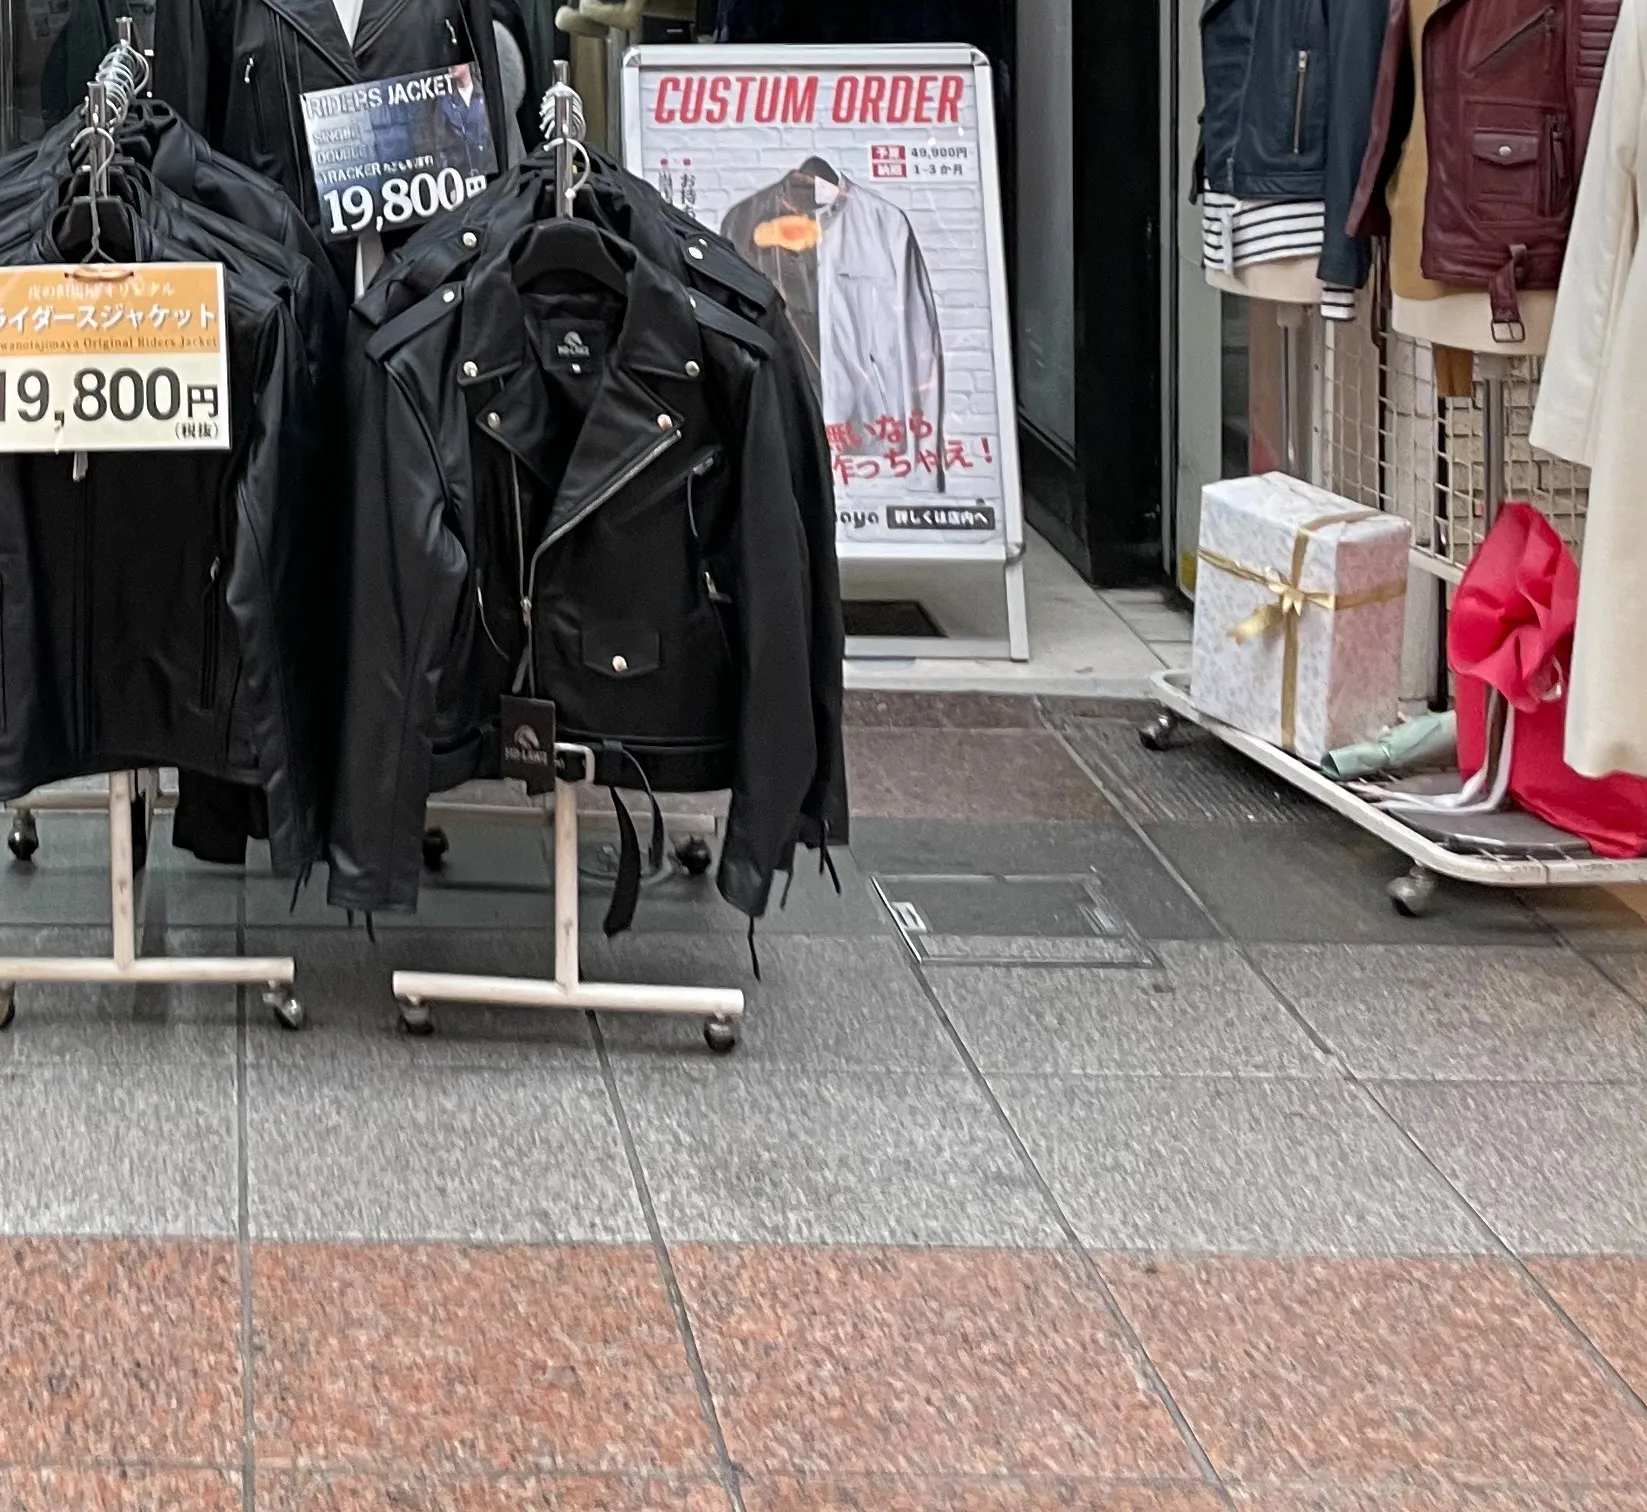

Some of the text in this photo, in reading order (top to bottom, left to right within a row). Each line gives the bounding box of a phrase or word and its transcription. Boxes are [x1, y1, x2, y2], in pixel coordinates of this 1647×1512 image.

[306, 73, 454, 119] RIDERS JACKET
[654, 75, 964, 124] CUSTUM ORDER
[320, 161, 382, 185] TRACKER
[84, 335, 134, 352] Original
[137, 335, 177, 350] Riders
[180, 334, 218, 349] Jacket
